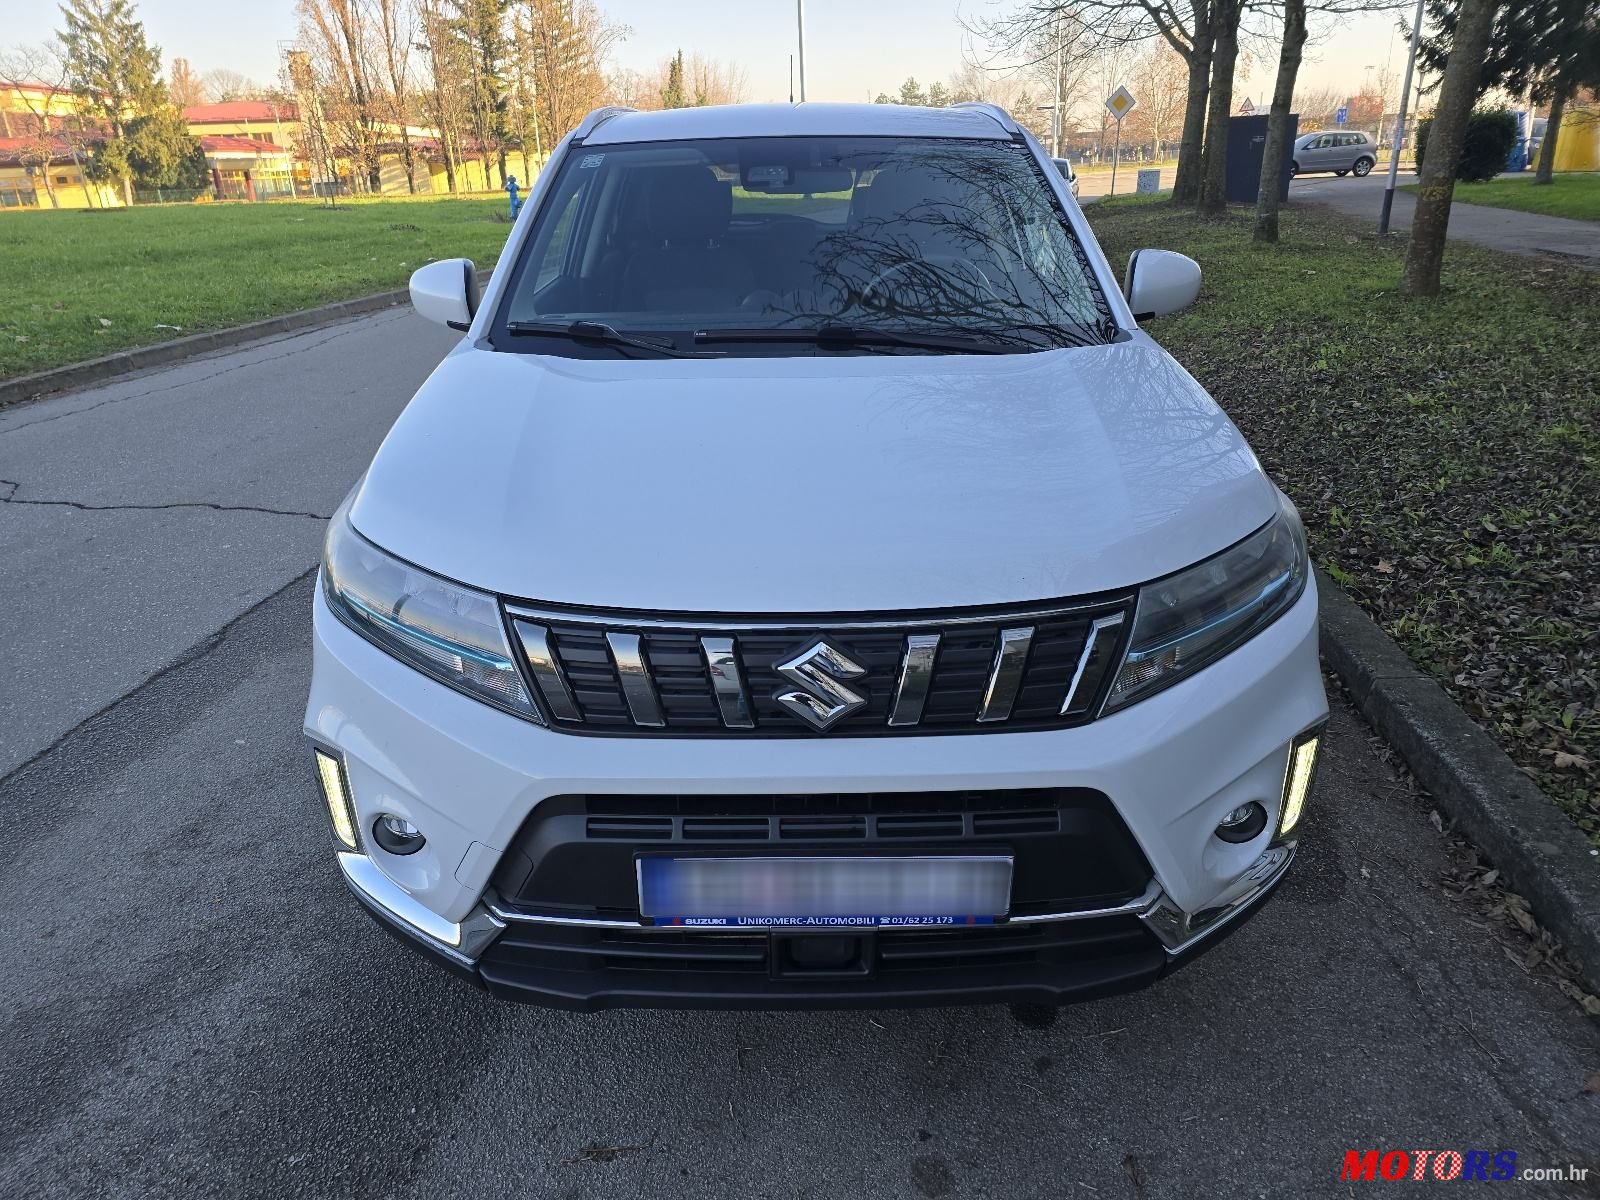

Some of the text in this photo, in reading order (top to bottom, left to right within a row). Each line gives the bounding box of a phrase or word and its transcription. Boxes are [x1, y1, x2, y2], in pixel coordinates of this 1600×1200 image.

[891, 916, 920, 925] 01/62
[922, 916, 934, 925] 25
[936, 916, 954, 925] 173
